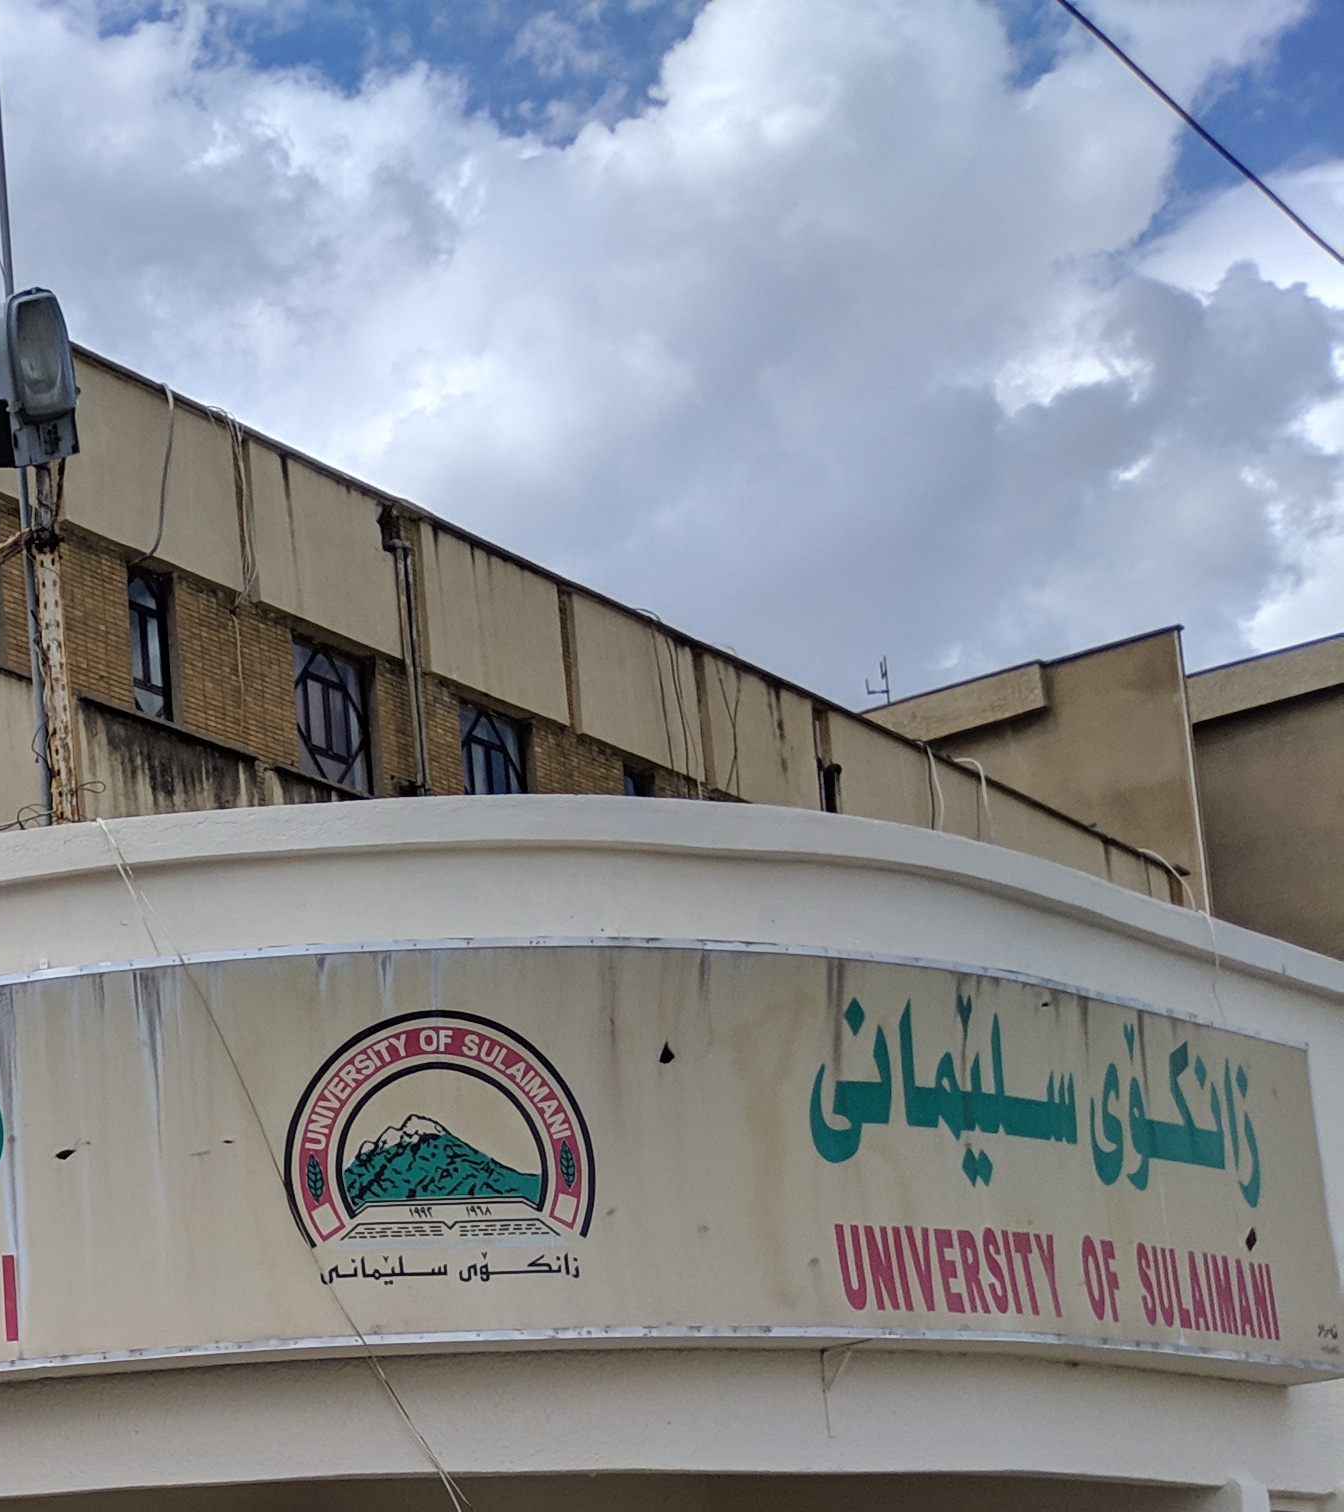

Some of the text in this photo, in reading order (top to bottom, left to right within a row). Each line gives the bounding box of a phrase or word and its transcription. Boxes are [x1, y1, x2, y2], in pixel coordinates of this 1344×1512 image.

[304, 1029, 573, 1151] UNIVERSITY OF SULAIMANI
[809, 993, 1261, 1208] زانکۆی سلێمانی
[458, 1251, 580, 1283] زانکۆی
[834, 1223, 1281, 1341] UNIVERSITY OF SULAIMANI
